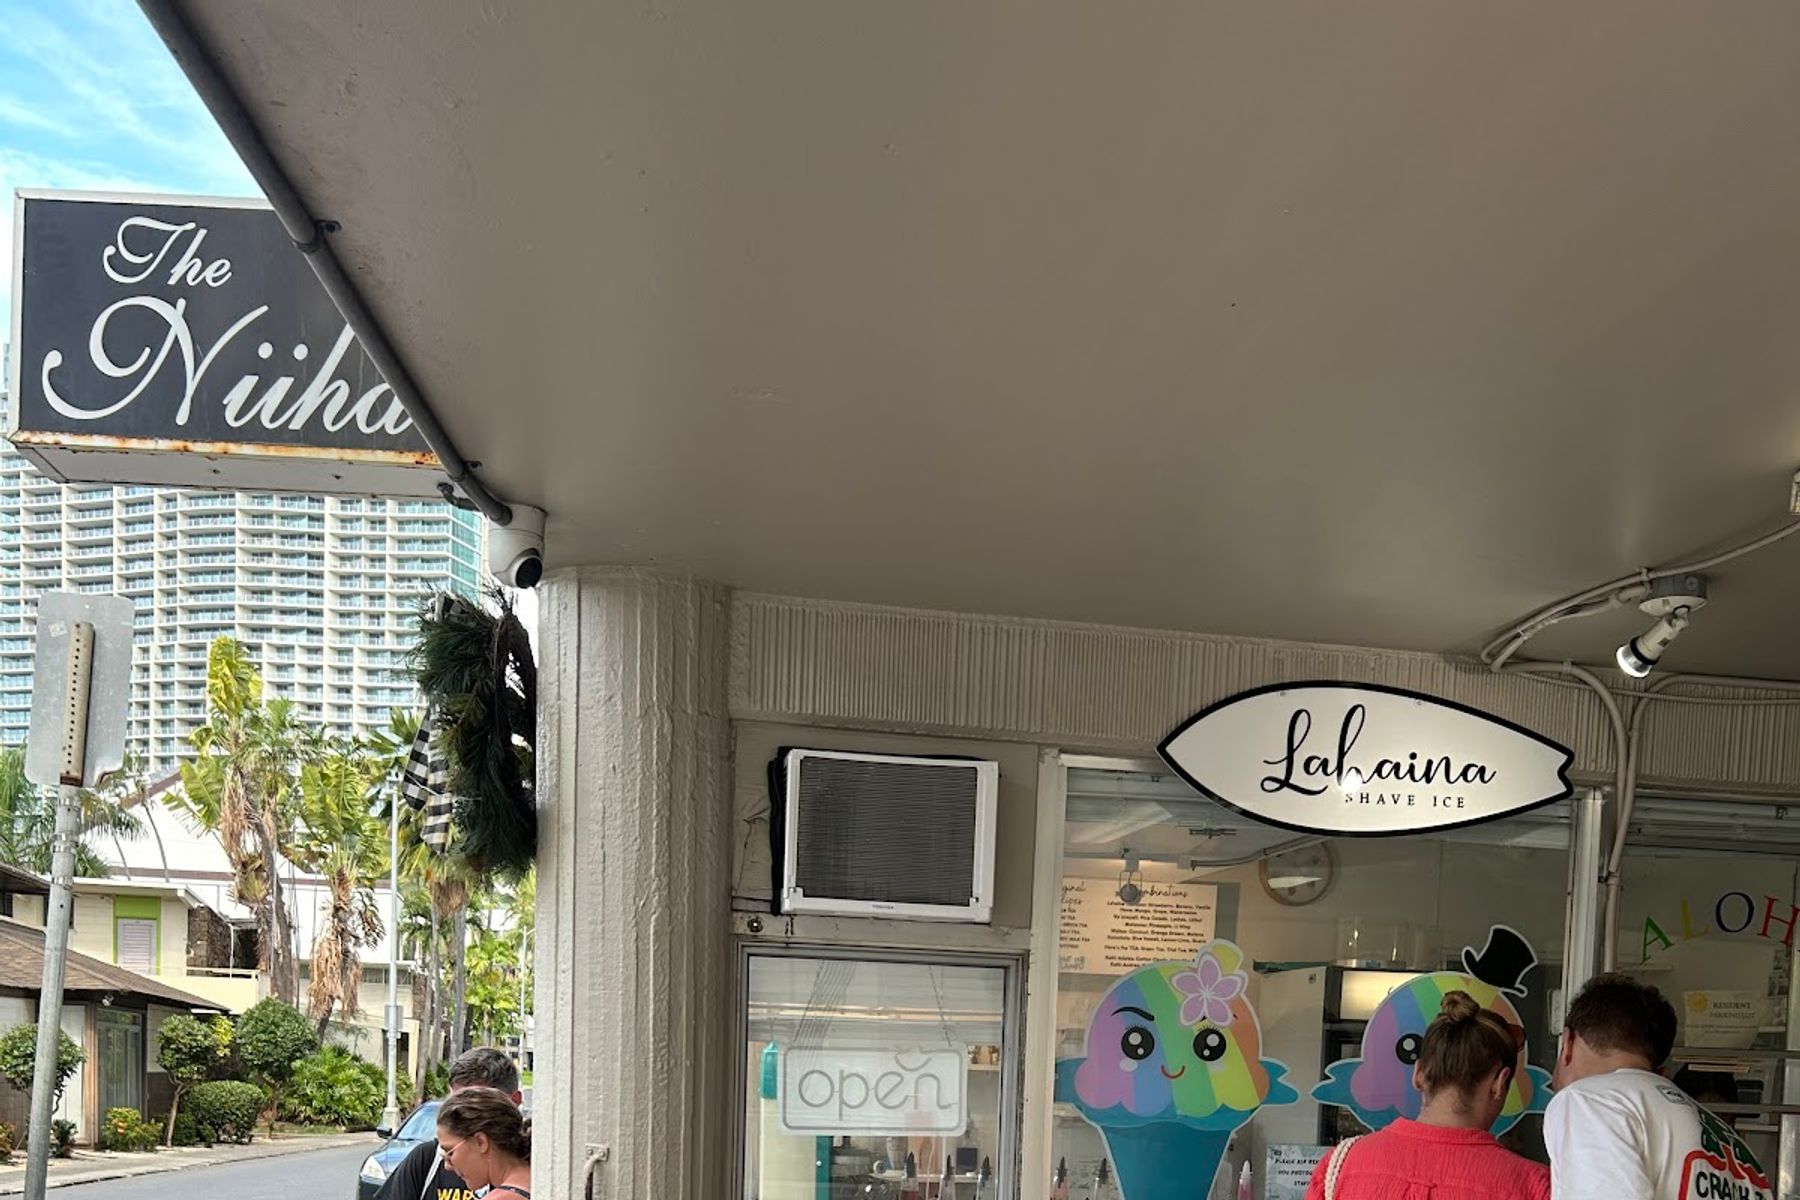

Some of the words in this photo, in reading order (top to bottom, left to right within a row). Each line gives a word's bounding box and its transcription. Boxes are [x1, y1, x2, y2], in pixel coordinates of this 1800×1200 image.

[102, 216, 233, 288] The
[1260, 703, 1498, 796] Lahaina
[1344, 792, 1416, 806] SHAVE
[1432, 796, 1466, 809] ICE
[799, 1069, 957, 1121] open
